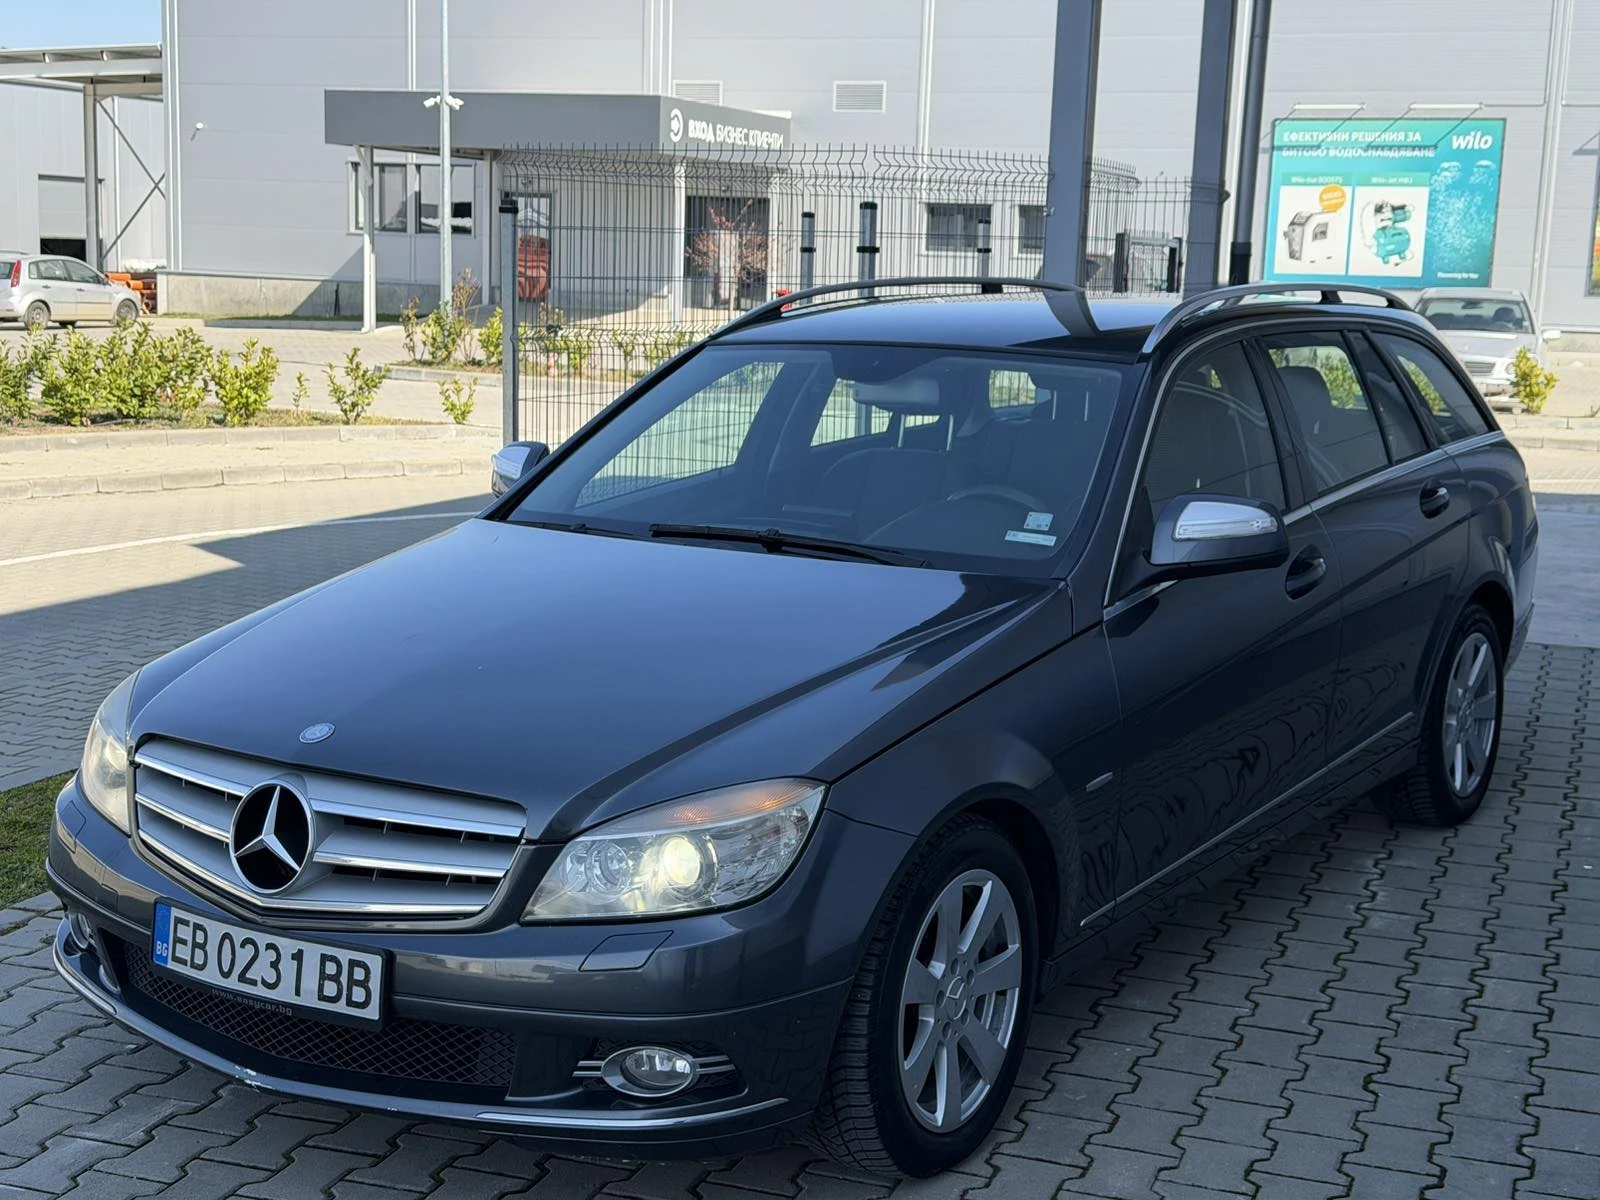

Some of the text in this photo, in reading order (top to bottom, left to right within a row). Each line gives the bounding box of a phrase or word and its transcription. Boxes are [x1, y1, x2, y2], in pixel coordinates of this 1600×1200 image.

[688, 119, 784, 150] ВХОД БИЗНЕС КЛИЕНТИ
[1283, 131, 1422, 142] ЕФЕКТИВНИ РЕШЕНИЯ ЗА
[1452, 130, 1493, 150] wilo
[1282, 146, 1436, 158] БИТОВО ВОДОСНАБДЯВАНЕ
[156, 940, 168, 957] BG
[171, 915, 373, 1010] EB 0231 BB
[211, 988, 293, 1016] www.easycar.bg
